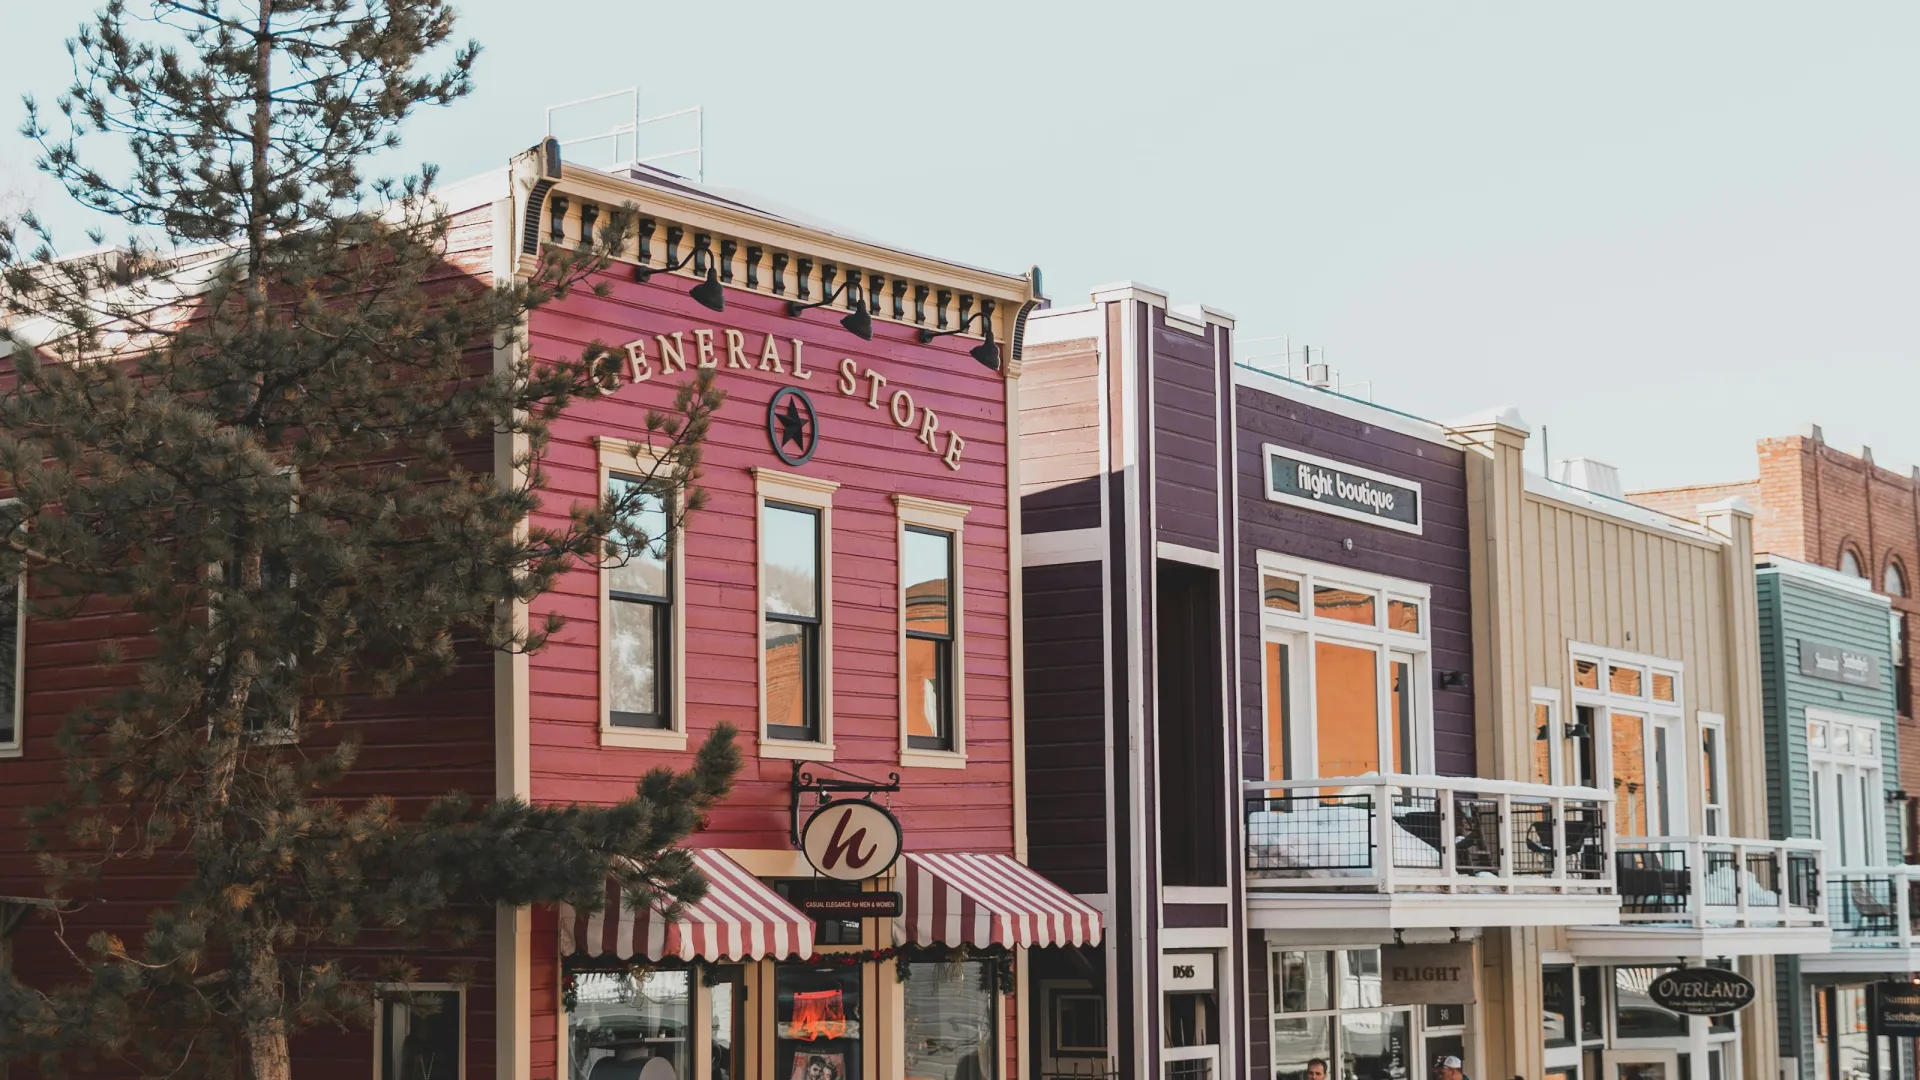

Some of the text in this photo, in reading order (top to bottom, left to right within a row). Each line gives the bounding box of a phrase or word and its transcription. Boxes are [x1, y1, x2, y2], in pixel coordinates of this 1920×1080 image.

[590, 329, 965, 471] GENERAL STORE
[1298, 465, 1394, 514] flight boutique
[1392, 966, 1461, 982] FLIGHT
[1659, 978, 1748, 998] OVERLAND
